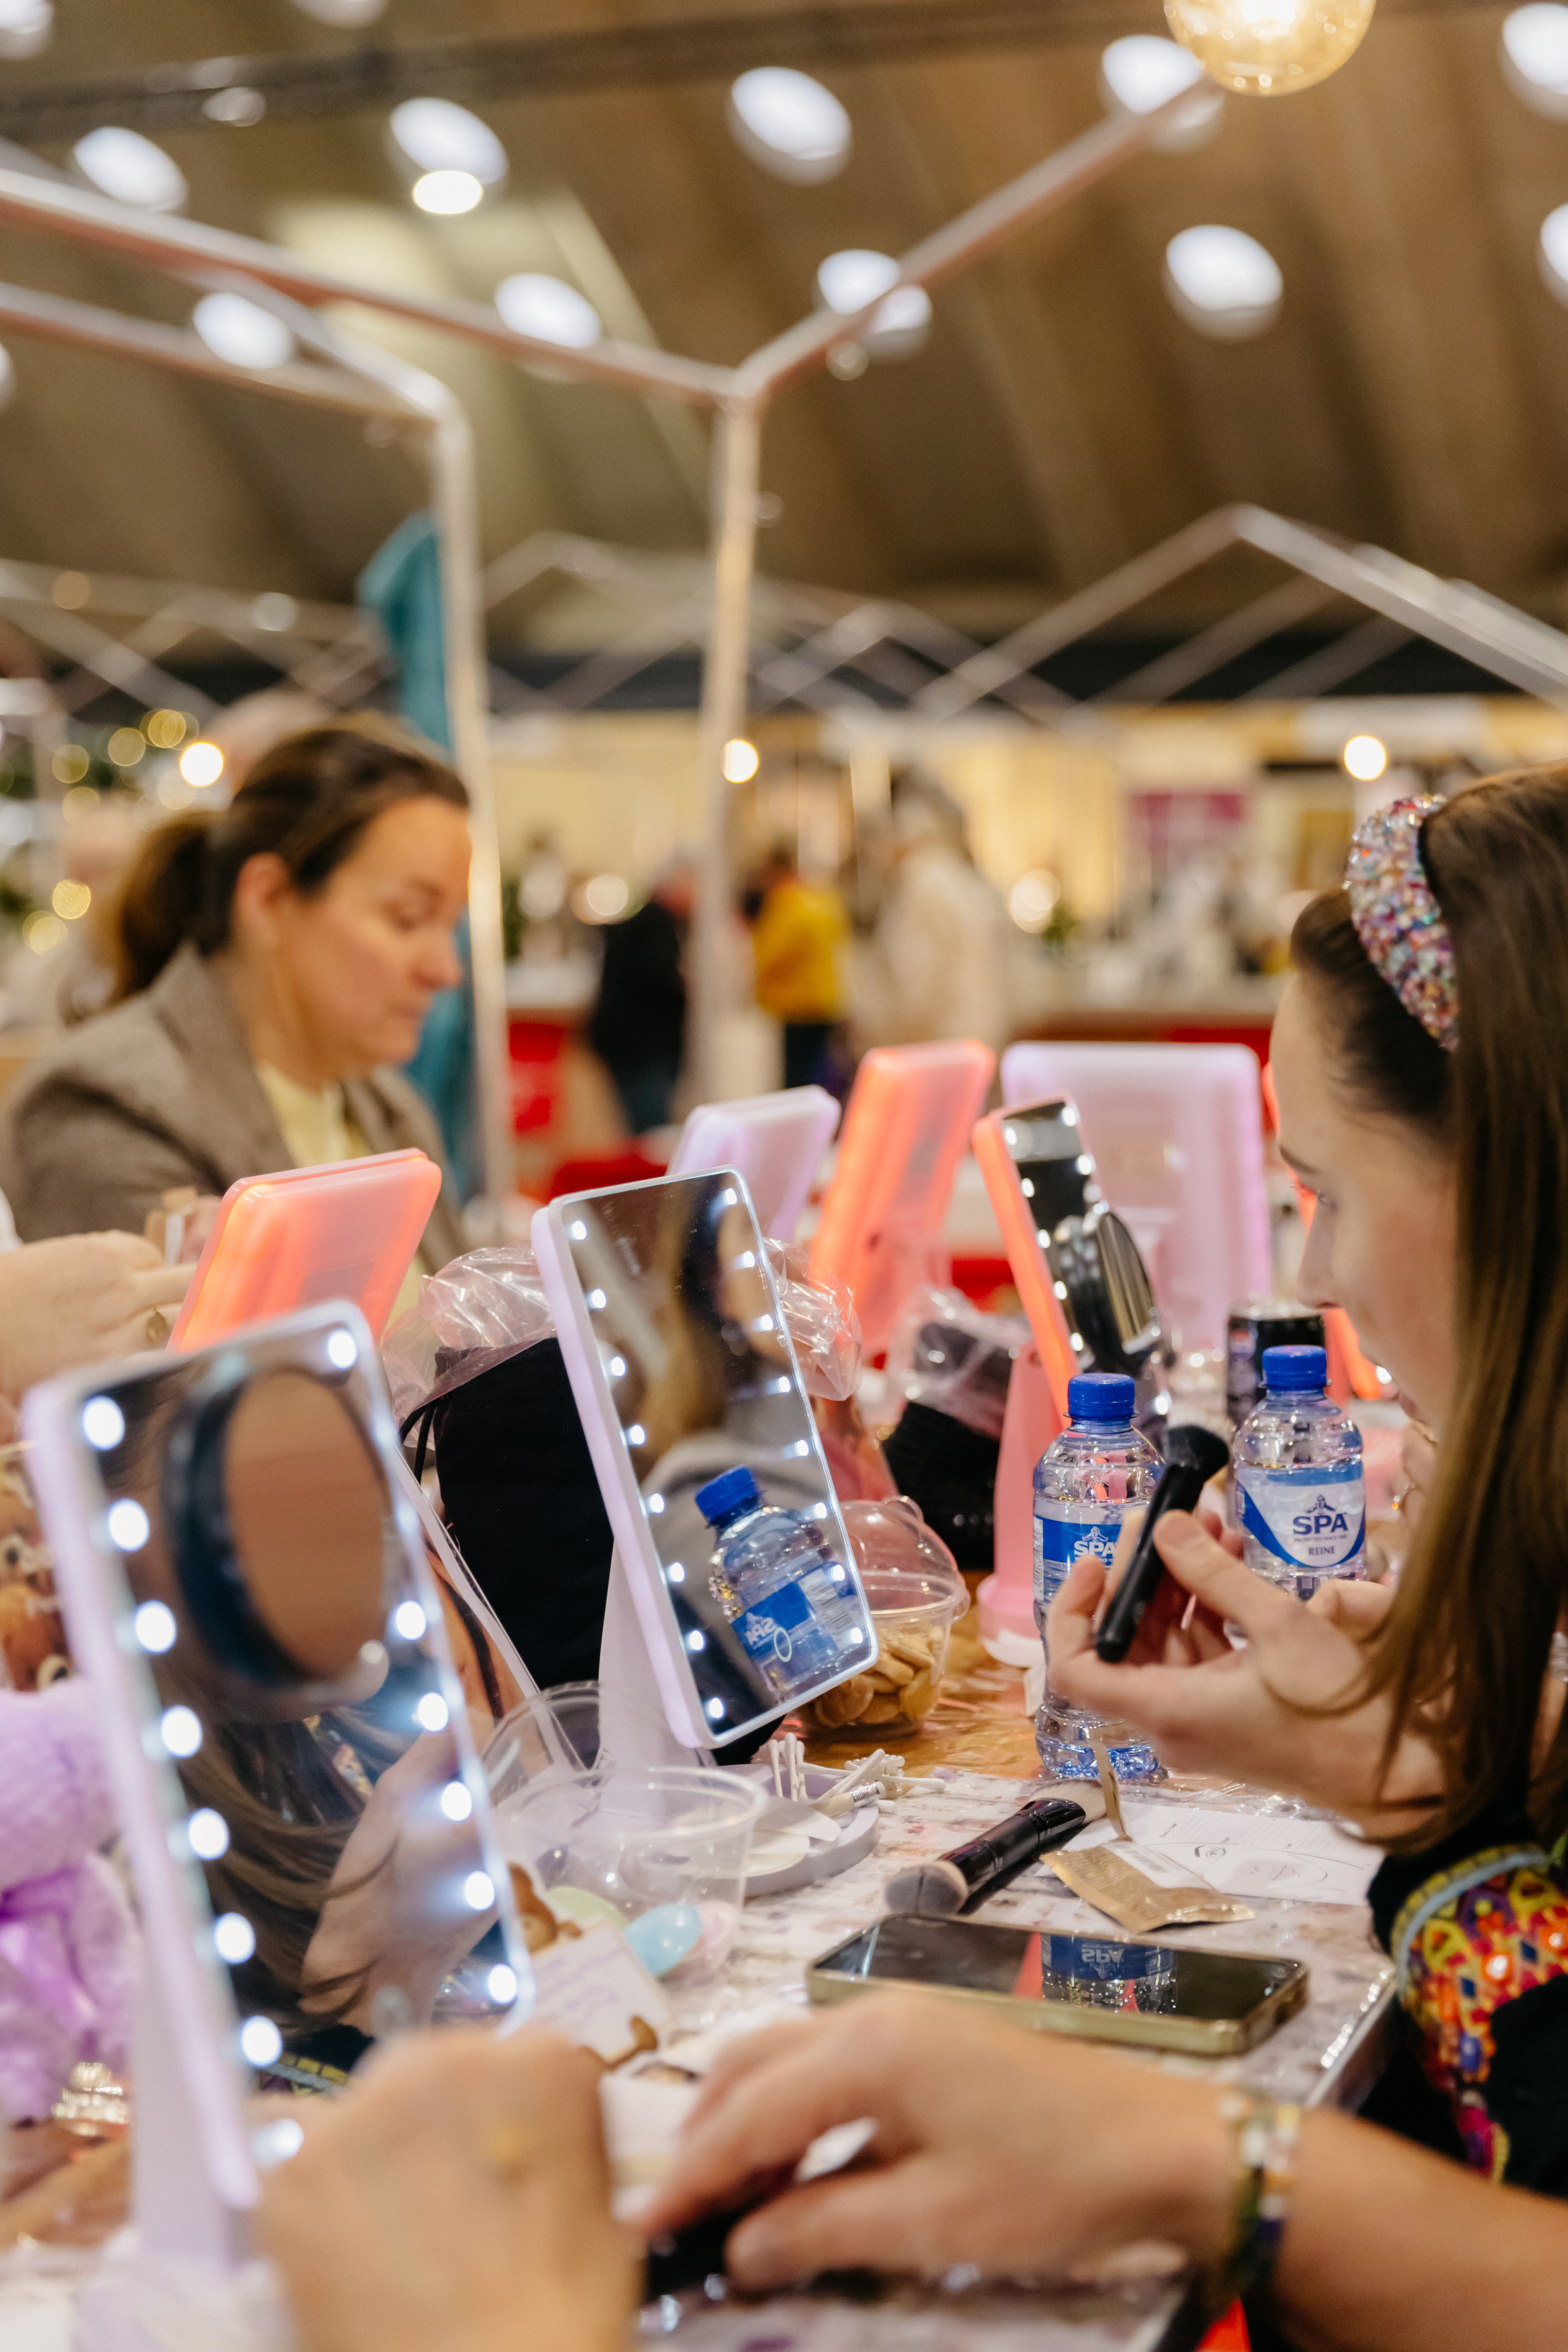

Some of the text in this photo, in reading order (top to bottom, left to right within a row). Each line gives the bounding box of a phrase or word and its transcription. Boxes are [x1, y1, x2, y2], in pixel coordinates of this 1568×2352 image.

[1293, 1514, 1348, 1535] SPA
[1074, 1541, 1116, 1556] SPA
[1309, 1546, 1335, 1555] REINE
